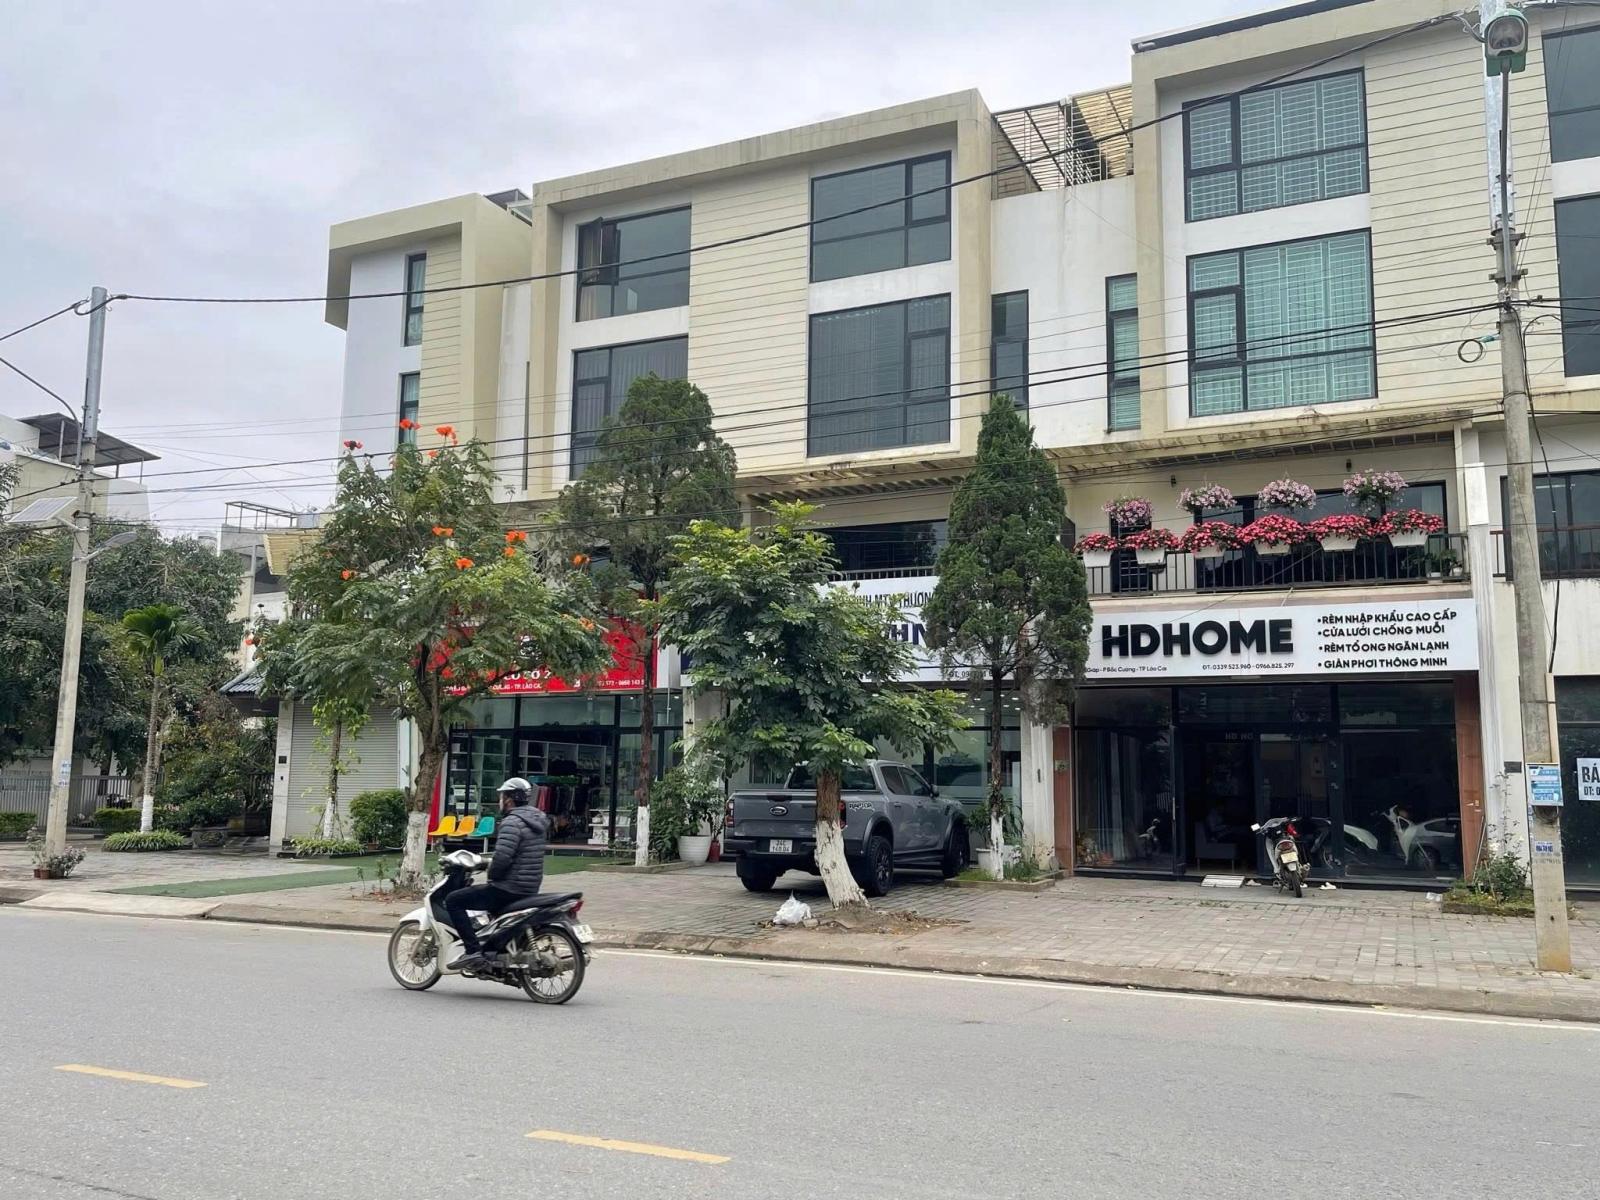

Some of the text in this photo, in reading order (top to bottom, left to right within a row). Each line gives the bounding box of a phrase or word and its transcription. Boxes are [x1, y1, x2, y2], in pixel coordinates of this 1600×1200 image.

[1322, 614, 1343, 624] RÈM
[1345, 613, 1373, 626] NHẬP
[1406, 612, 1431, 622] CAO
[1433, 608, 1457, 620] CẤP
[1373, 623, 1413, 636] CHỐNG
[1102, 619, 1293, 657] HDHOME
[1324, 642, 1344, 653] RÈM
[1361, 643, 1386, 652] ONG
[1387, 641, 1419, 651] NGĂN
[1420, 641, 1449, 653] LẠNH
[1351, 658, 1377, 668] PHƠI
[1379, 657, 1418, 668] THÔNG
[1420, 657, 1447, 667] MINH
